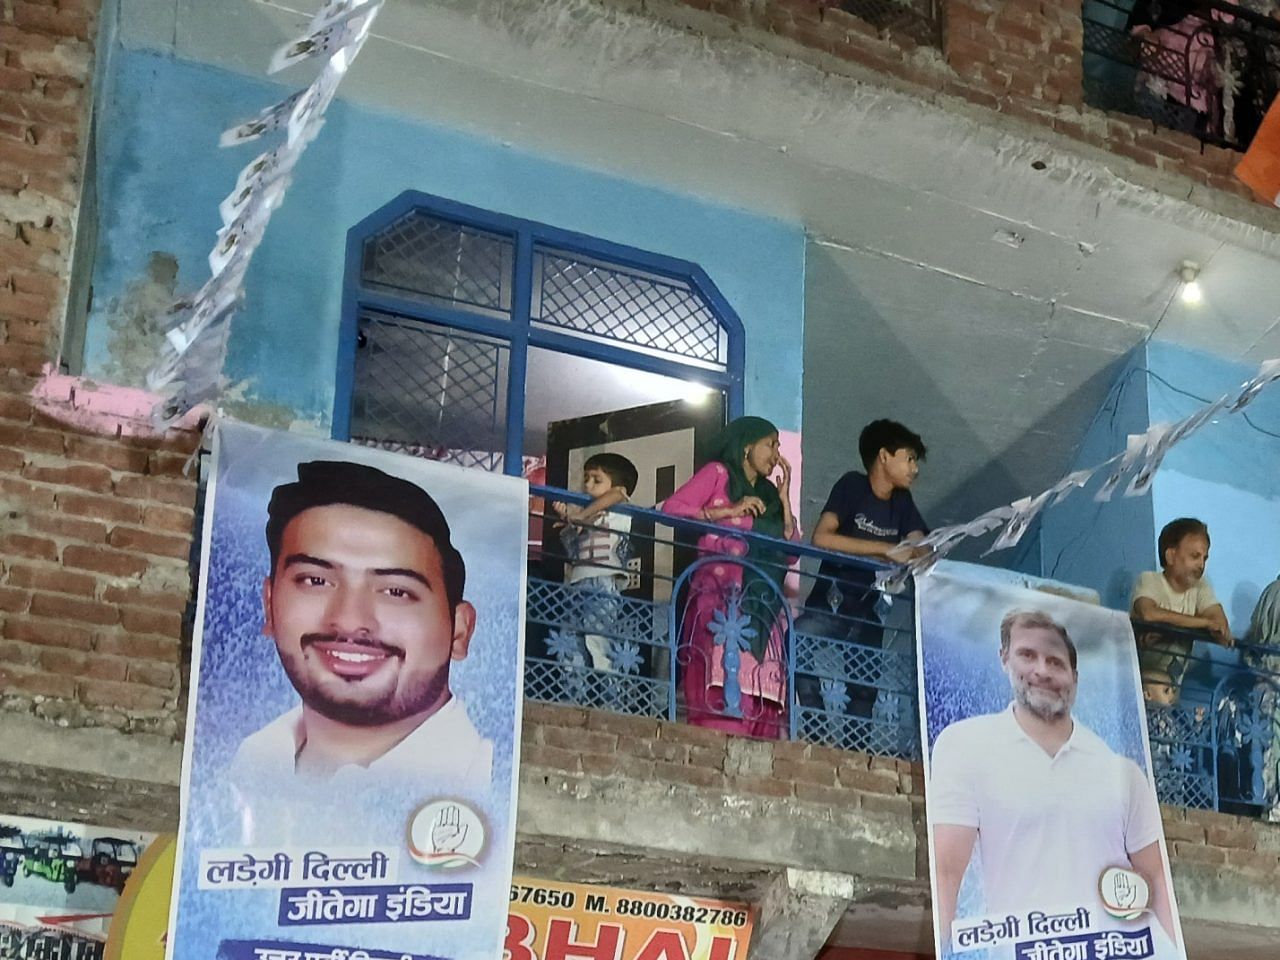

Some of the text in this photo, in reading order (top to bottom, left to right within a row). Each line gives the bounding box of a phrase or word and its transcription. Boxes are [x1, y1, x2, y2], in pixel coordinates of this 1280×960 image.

[205, 850, 390, 886] लड़ेगी दिल्ली
[287, 886, 468, 921] जीतेगा इंडिया
[585, 895, 610, 913] M.
[616, 899, 746, 927] 8800382786
[957, 906, 1091, 947] लड़ेगी दिल्ली
[1094, 931, 1149, 960] इंडिया
